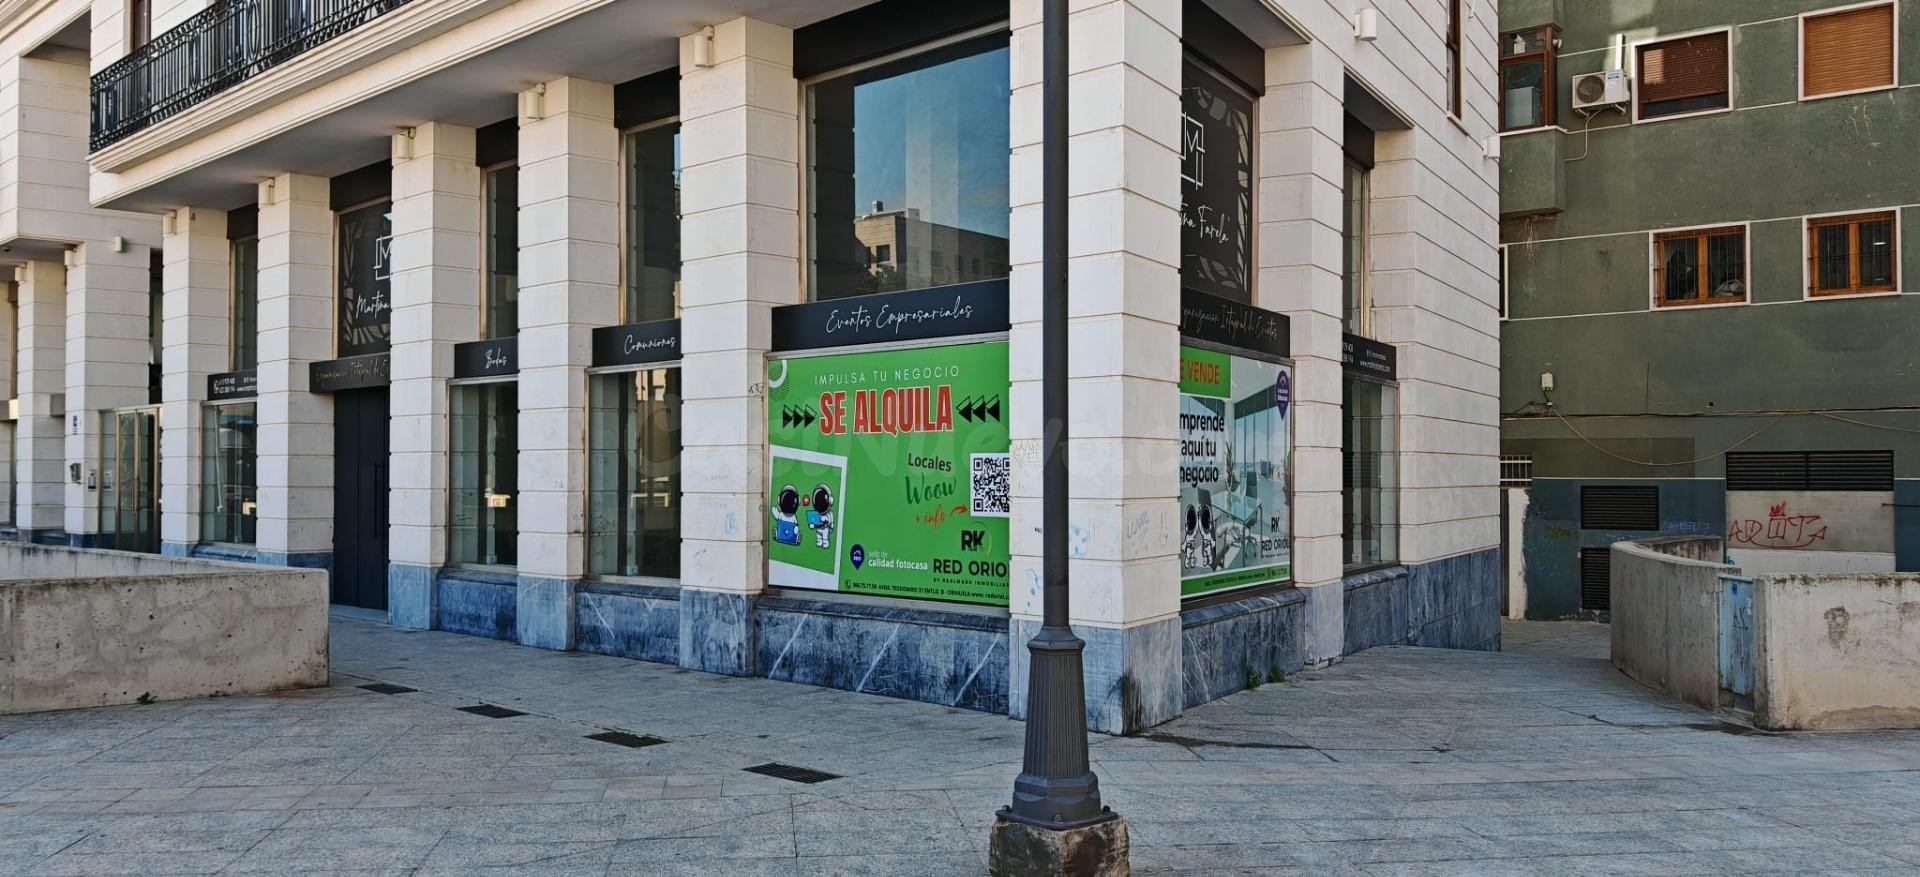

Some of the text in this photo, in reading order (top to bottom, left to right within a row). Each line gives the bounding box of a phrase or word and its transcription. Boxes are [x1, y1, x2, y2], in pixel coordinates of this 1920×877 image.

[826, 295, 974, 334] Eventos Empresariales
[624, 334, 676, 355] Comuniones
[485, 347, 508, 369] Bodas
[814, 365, 960, 386] IMPULSA TU NEGOCIO
[1187, 359, 1220, 385] VENDE
[819, 385, 954, 438] SE ALQUILA
[1181, 438, 1217, 459] aquí tu
[908, 452, 952, 472] Locales
[905, 472, 957, 505] Woow
[1271, 516, 1280, 534] RK
[961, 530, 986, 552] RK
[1261, 539, 1273, 552] RED
[868, 557, 894, 569] calidad
[896, 559, 928, 571] fotocasa
[933, 558, 963, 575] RED
